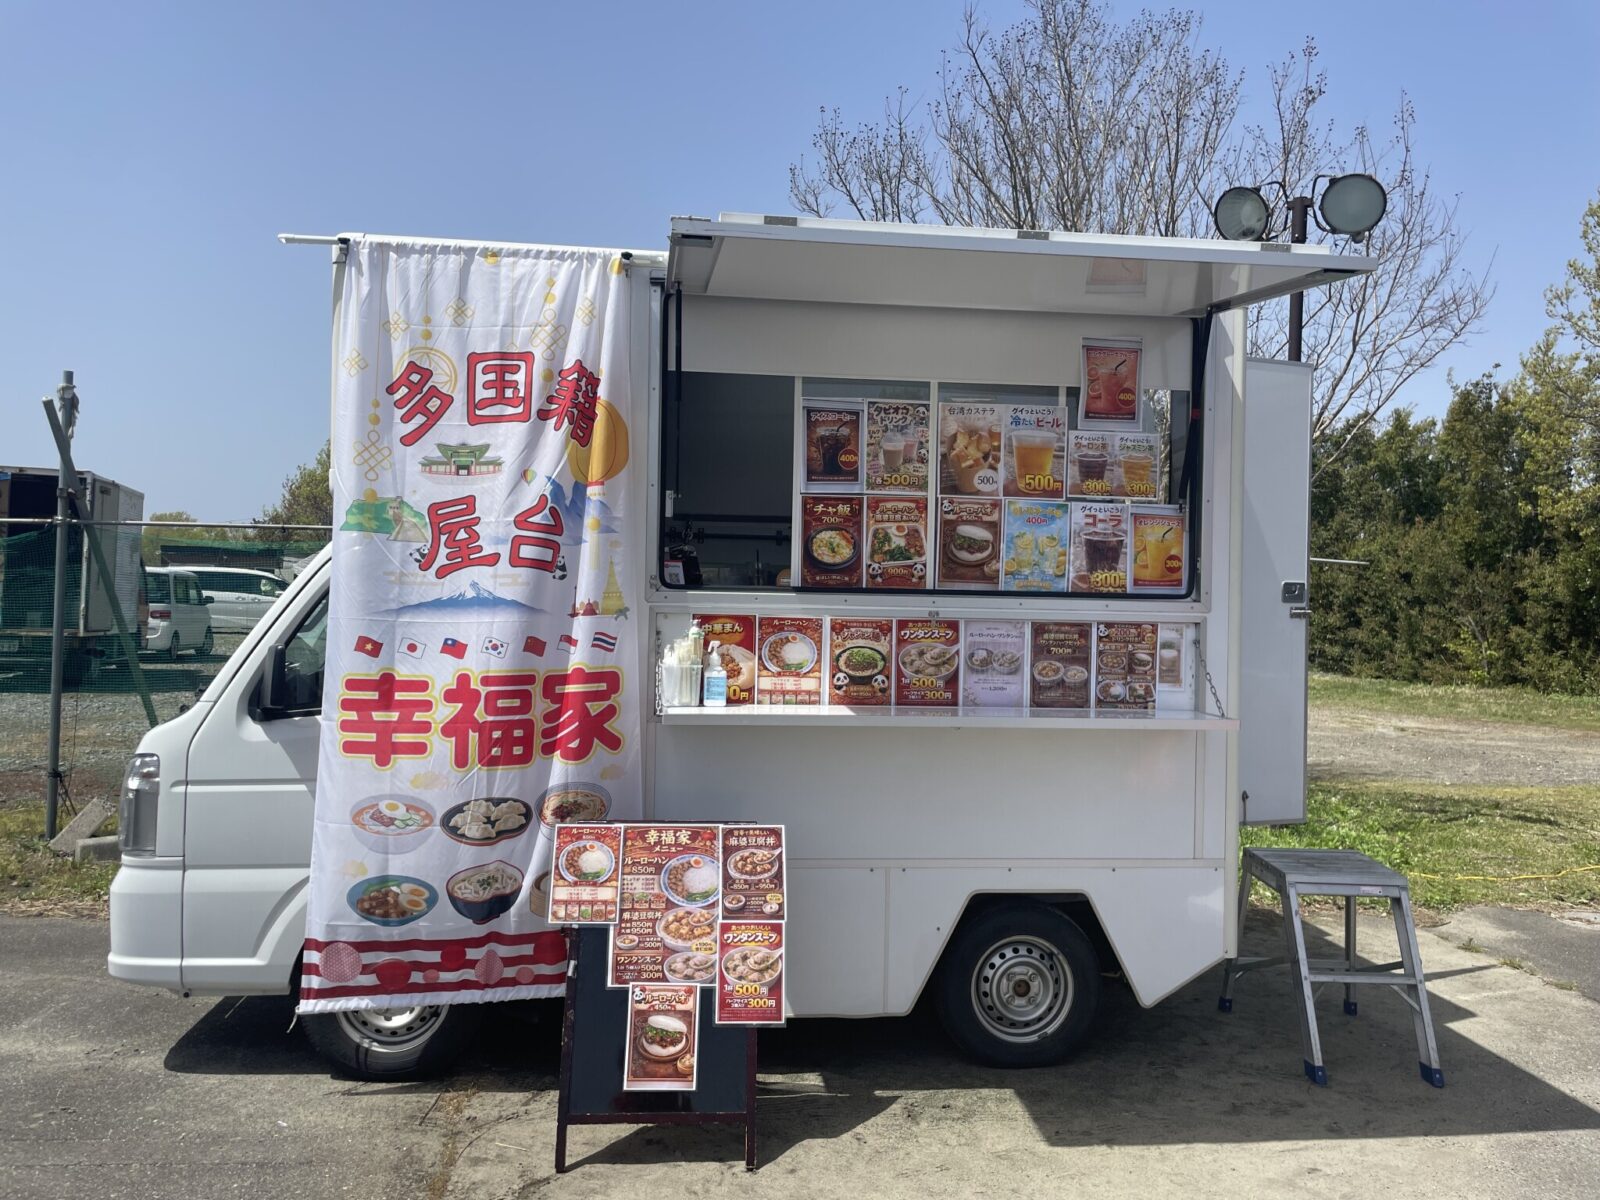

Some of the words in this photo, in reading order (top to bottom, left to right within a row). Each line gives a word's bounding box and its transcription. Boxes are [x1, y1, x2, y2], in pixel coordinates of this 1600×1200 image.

[386, 350, 603, 447] 多国籍
[873, 404, 910, 417] タピオカ
[948, 406, 995, 415] 台湾カステラ
[810, 411, 857, 421] アイスコーヒー
[879, 415, 912, 426] ドリンク
[1010, 415, 1062, 428] 冷たいビール
[1074, 442, 1108, 450] ウーロン茶
[977, 476, 998, 485] 500円
[1025, 474, 1062, 491] 500円
[813, 503, 851, 515] チャ飯
[879, 505, 916, 514] ルーローハン
[953, 505, 994, 515] ルーローバオ
[822, 516, 844, 524] 700円
[1025, 516, 1048, 524] 400円
[1084, 514, 1122, 527] コーラ
[1136, 519, 1181, 527] オレンジジュース
[420, 494, 567, 580] 屋台
[887, 567, 909, 575] 900円
[702, 622, 743, 635] 中華まん
[900, 630, 953, 640] ワンタンスープ
[1050, 647, 1073, 655] 700円
[911, 678, 945, 688] 500円
[727, 685, 749, 700] 0円
[924, 690, 952, 700] 300円
[338, 667, 624, 768] 幸福家
[645, 829, 692, 845] 幸福家
[729, 836, 776, 846] 麻婆豆腐丼
[624, 856, 670, 864] ルーローハン
[631, 866, 656, 874] 850円
[622, 911, 662, 920] 麻婆豆腐丼
[724, 932, 778, 943] ワンタンスープ
[724, 984, 734, 992] 1杯
[734, 984, 768, 996] 500円
[645, 993, 687, 1004] ルーローバオ
[747, 998, 776, 1008] 300円
